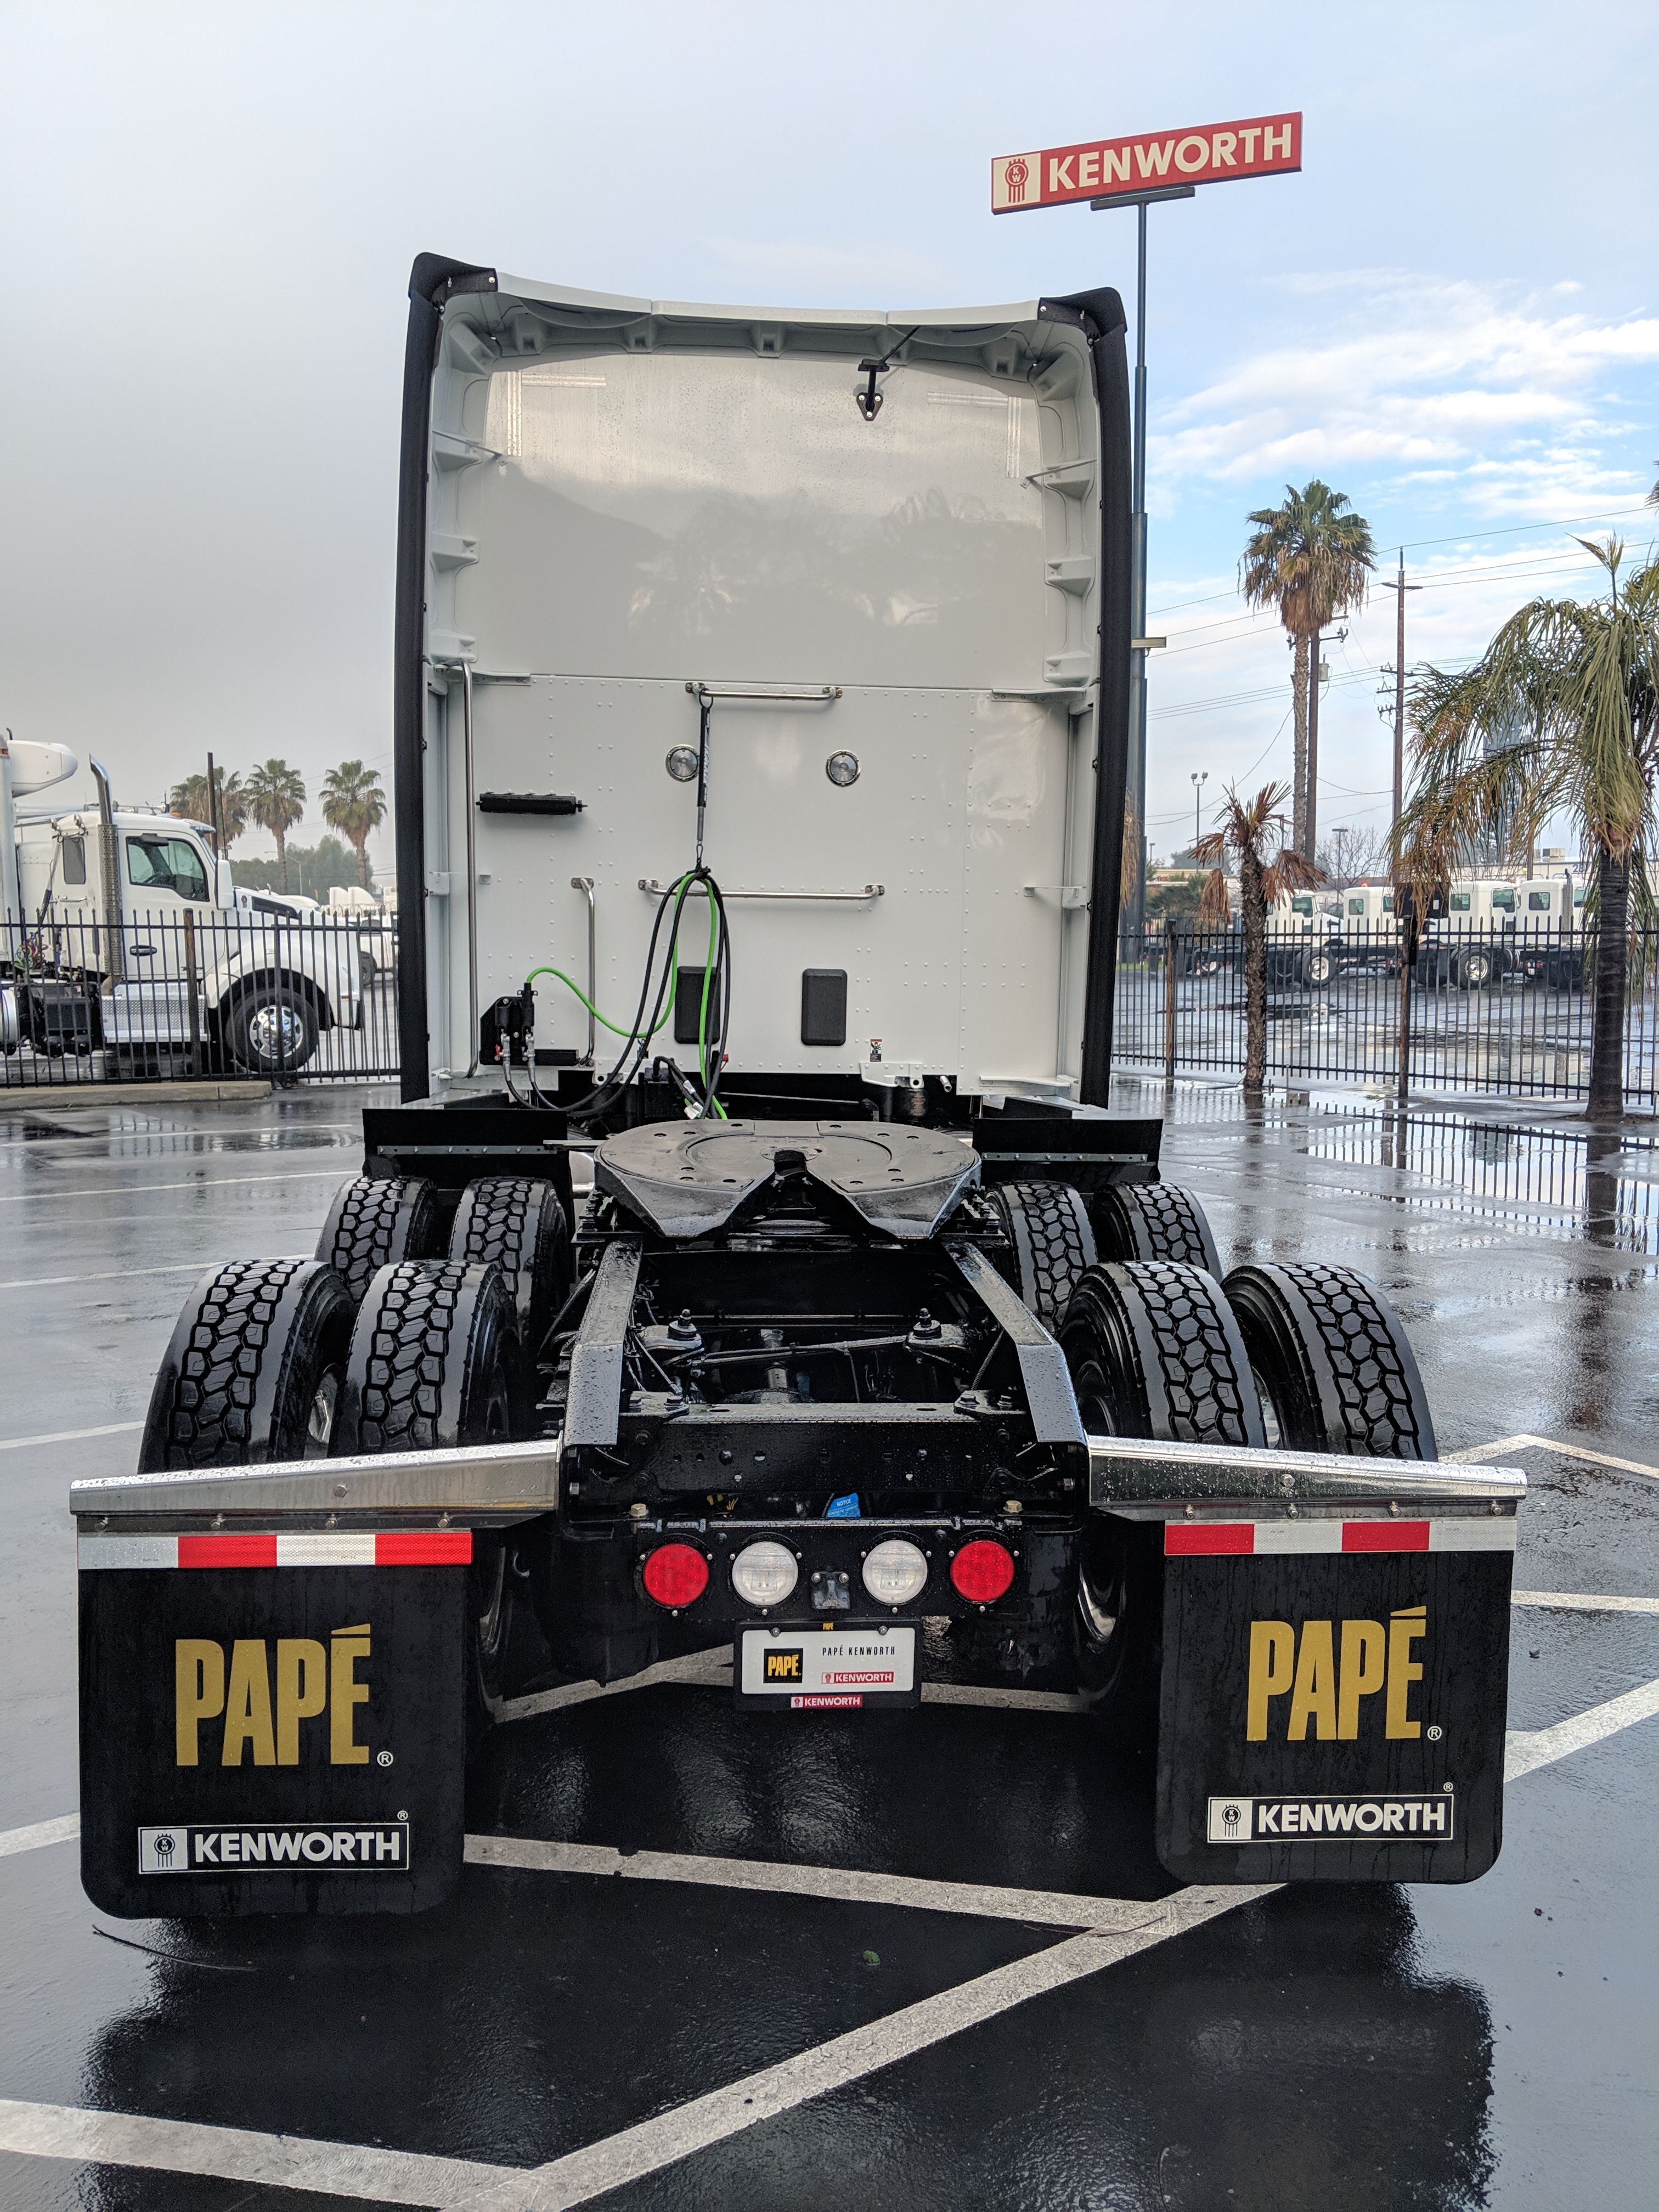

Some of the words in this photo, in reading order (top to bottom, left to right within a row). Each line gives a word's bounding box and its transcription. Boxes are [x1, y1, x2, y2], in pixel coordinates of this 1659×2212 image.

[1049, 123, 1292, 192] KENWORTH
[837, 1498, 851, 1506] NOTICE
[822, 1644, 844, 1656] PAPÉ
[848, 1646, 895, 1656] KENWORTH
[768, 1654, 799, 1676] PAPÉ
[836, 1673, 892, 1683] KENWORTH
[1246, 1605, 1426, 1741] PAPÉ
[176, 1623, 371, 1767] PAPÉ
[804, 1697, 860, 1706] KENWORTH
[1258, 1803, 1445, 1833] KENWORTH
[195, 1831, 399, 1863] KENWORTH
